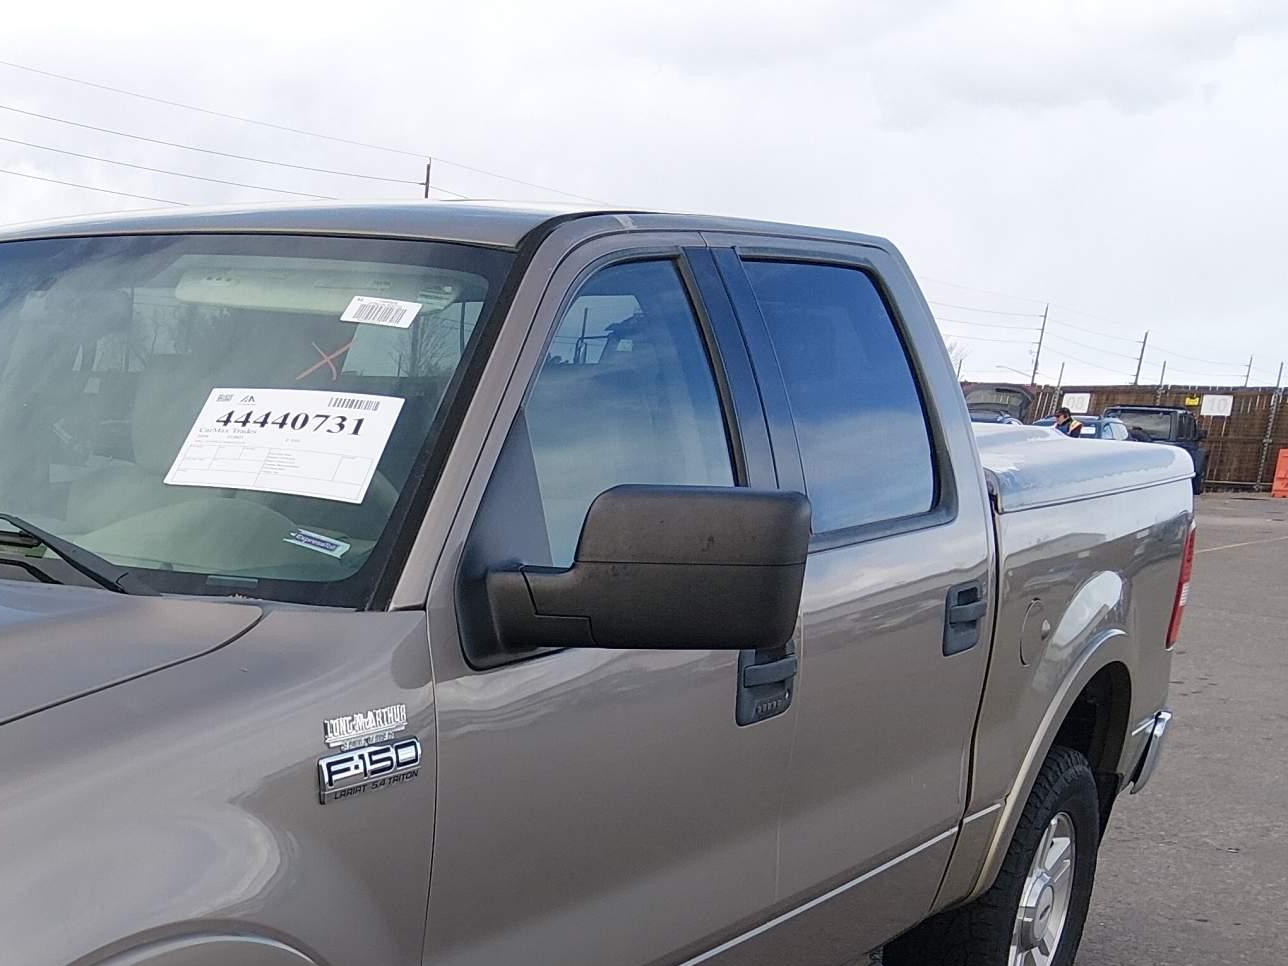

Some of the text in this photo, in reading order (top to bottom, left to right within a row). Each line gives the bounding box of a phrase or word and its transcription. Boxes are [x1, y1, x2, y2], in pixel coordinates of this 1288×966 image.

[216, 409, 365, 437] 44440731
[334, 784, 368, 800] LARIAT
[388, 770, 420, 784] TRITON
